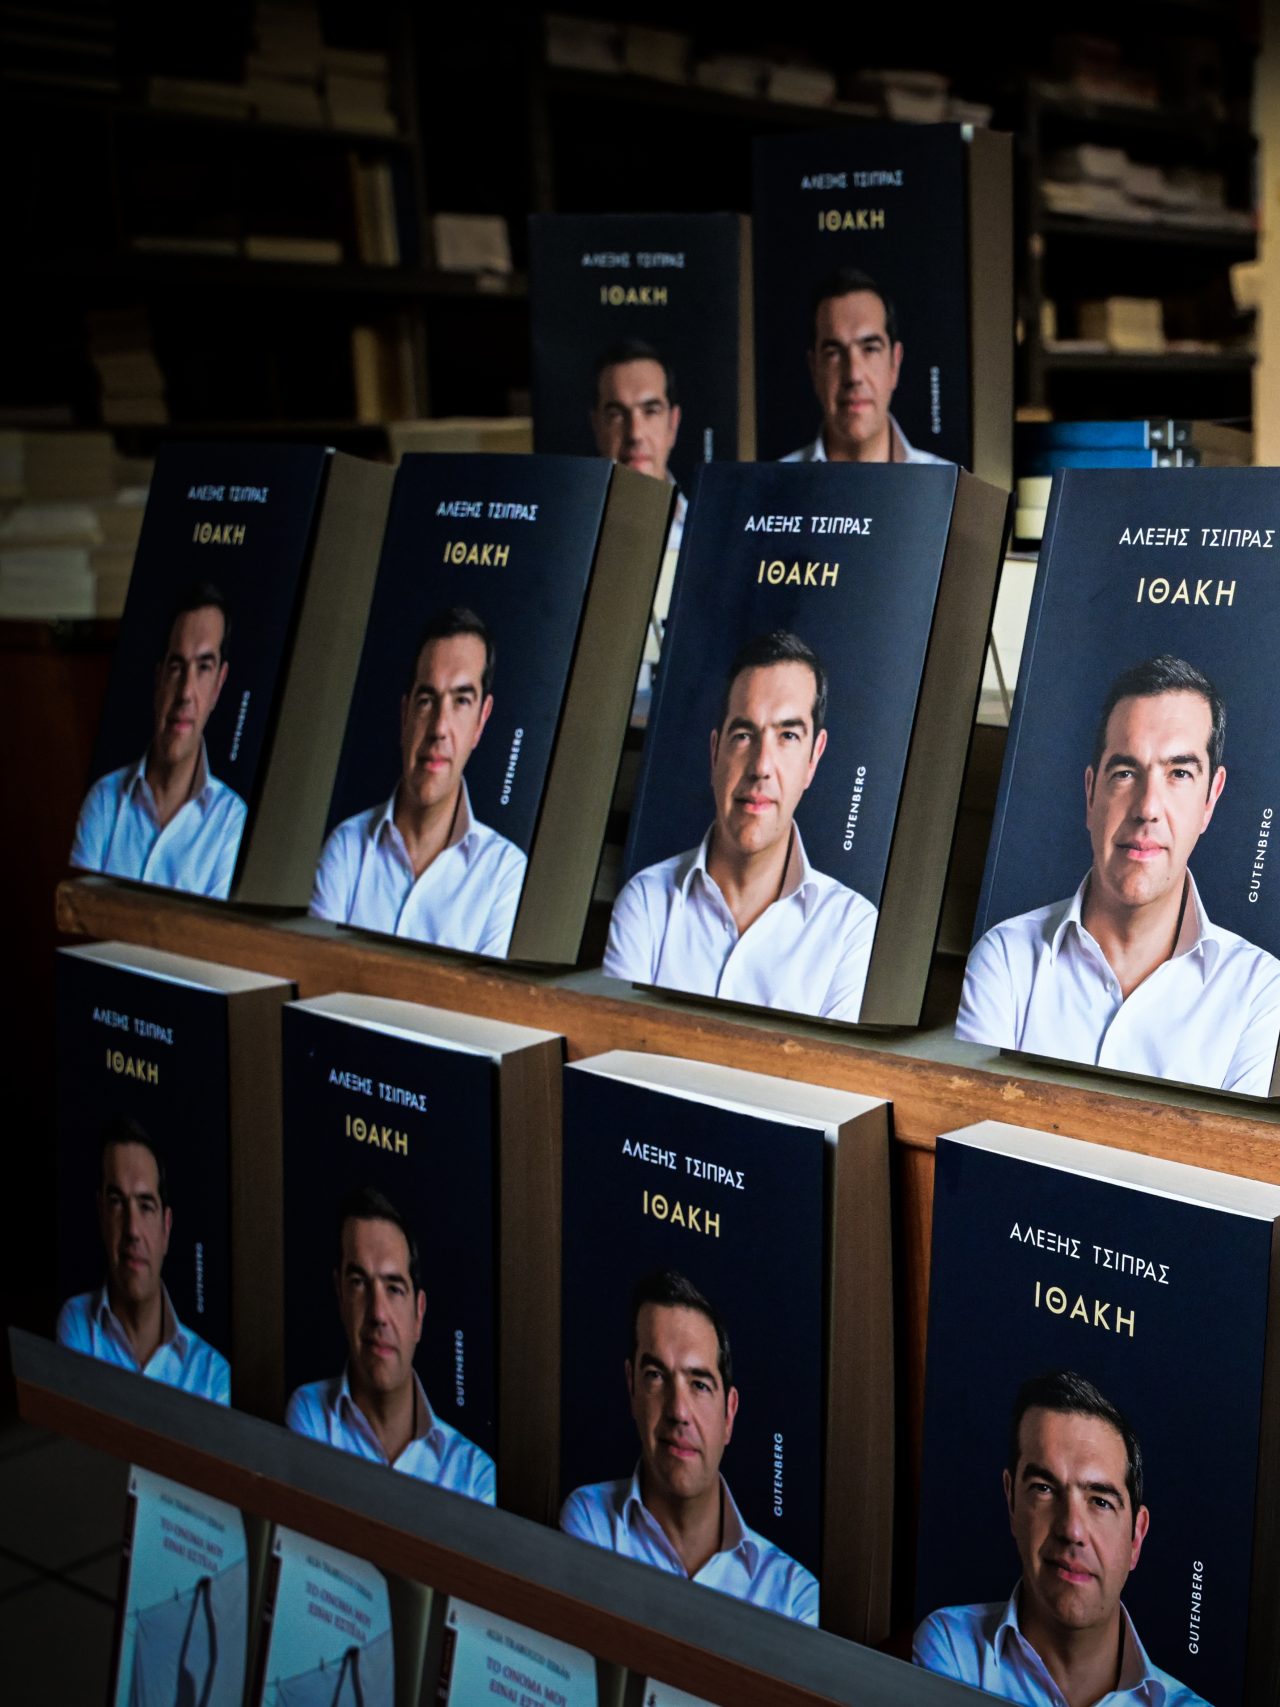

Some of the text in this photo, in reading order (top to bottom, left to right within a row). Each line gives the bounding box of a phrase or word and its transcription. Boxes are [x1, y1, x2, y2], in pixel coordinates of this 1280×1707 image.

[818, 209, 885, 231] ΙΘΑΚΗ
[600, 285, 668, 306] ΙΘΑΚΗ
[437, 500, 539, 522] ΑΛΕΞΗΣ ΤΣΙΠΡΑΣ
[744, 515, 873, 535] ΑΛΕΞΗΣ ΤΣΙΠΡΑΣ
[193, 522, 246, 545] ΙΘΑΚΗ
[443, 541, 510, 567] ΙΘΑΚΗ
[1118, 527, 1276, 548] ΑΛΕΞΗΣ ΤΣΙΠΡΑΣ
[757, 560, 840, 587] ΙΘΑΚΗ
[1136, 577, 1237, 607] ΙΘΑΚΗ
[500, 727, 524, 806] GUTENBERG
[843, 765, 867, 851] GUTENBERG
[1248, 807, 1273, 903] GUTENBERG
[106, 1049, 159, 1085] ΙΘΑΚΗ
[328, 1068, 428, 1113] ΑΛΕΞΗΣ ΤΣΙΠΡΑΣ
[345, 1114, 408, 1156] ΙΘΑΚΗ
[622, 1138, 745, 1190] ΑΛΕΞΗΣ ΤΣΙΠΡΑΣ
[643, 1190, 720, 1238] ΙΘΑΚΗ
[1009, 1222, 1170, 1285] ΑΛΕΞΗΣ ΤΣΙΠΡΑΣ
[1034, 1281, 1135, 1337] ΙΘΑΚΗ
[454, 1329, 465, 1407] GUTENBERG
[773, 1432, 784, 1517] GUTENBERG
[1188, 1560, 1204, 1655] GUTENBERG
